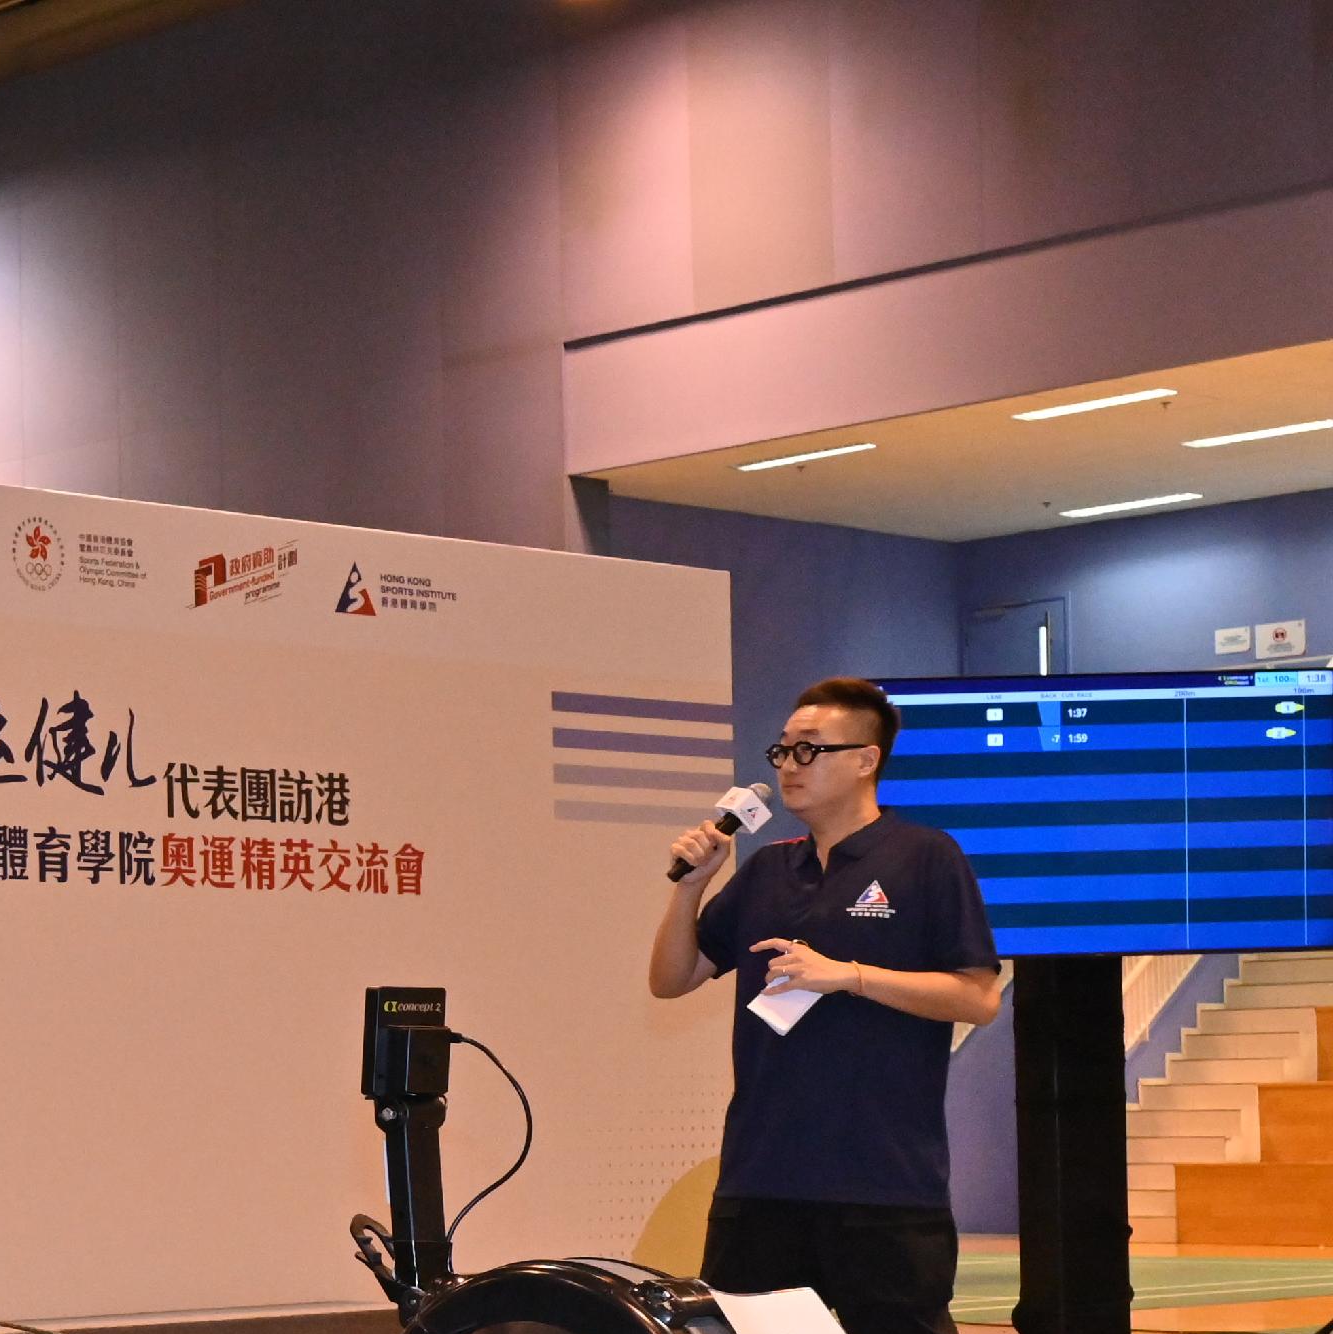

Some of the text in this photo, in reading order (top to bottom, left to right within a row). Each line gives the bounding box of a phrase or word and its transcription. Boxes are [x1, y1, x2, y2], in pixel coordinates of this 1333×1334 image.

[230, 546, 275, 576] 政府資助
[209, 571, 275, 601] Government-funded
[380, 574, 432, 588] HONG KONG
[244, 581, 280, 602] programme
[380, 586, 457, 601] SPORTS INSTITUTE
[1068, 733, 1088, 744] 1:59
[163, 763, 351, 827] 代表團訪港
[397, 1001, 442, 1012] concept 2
